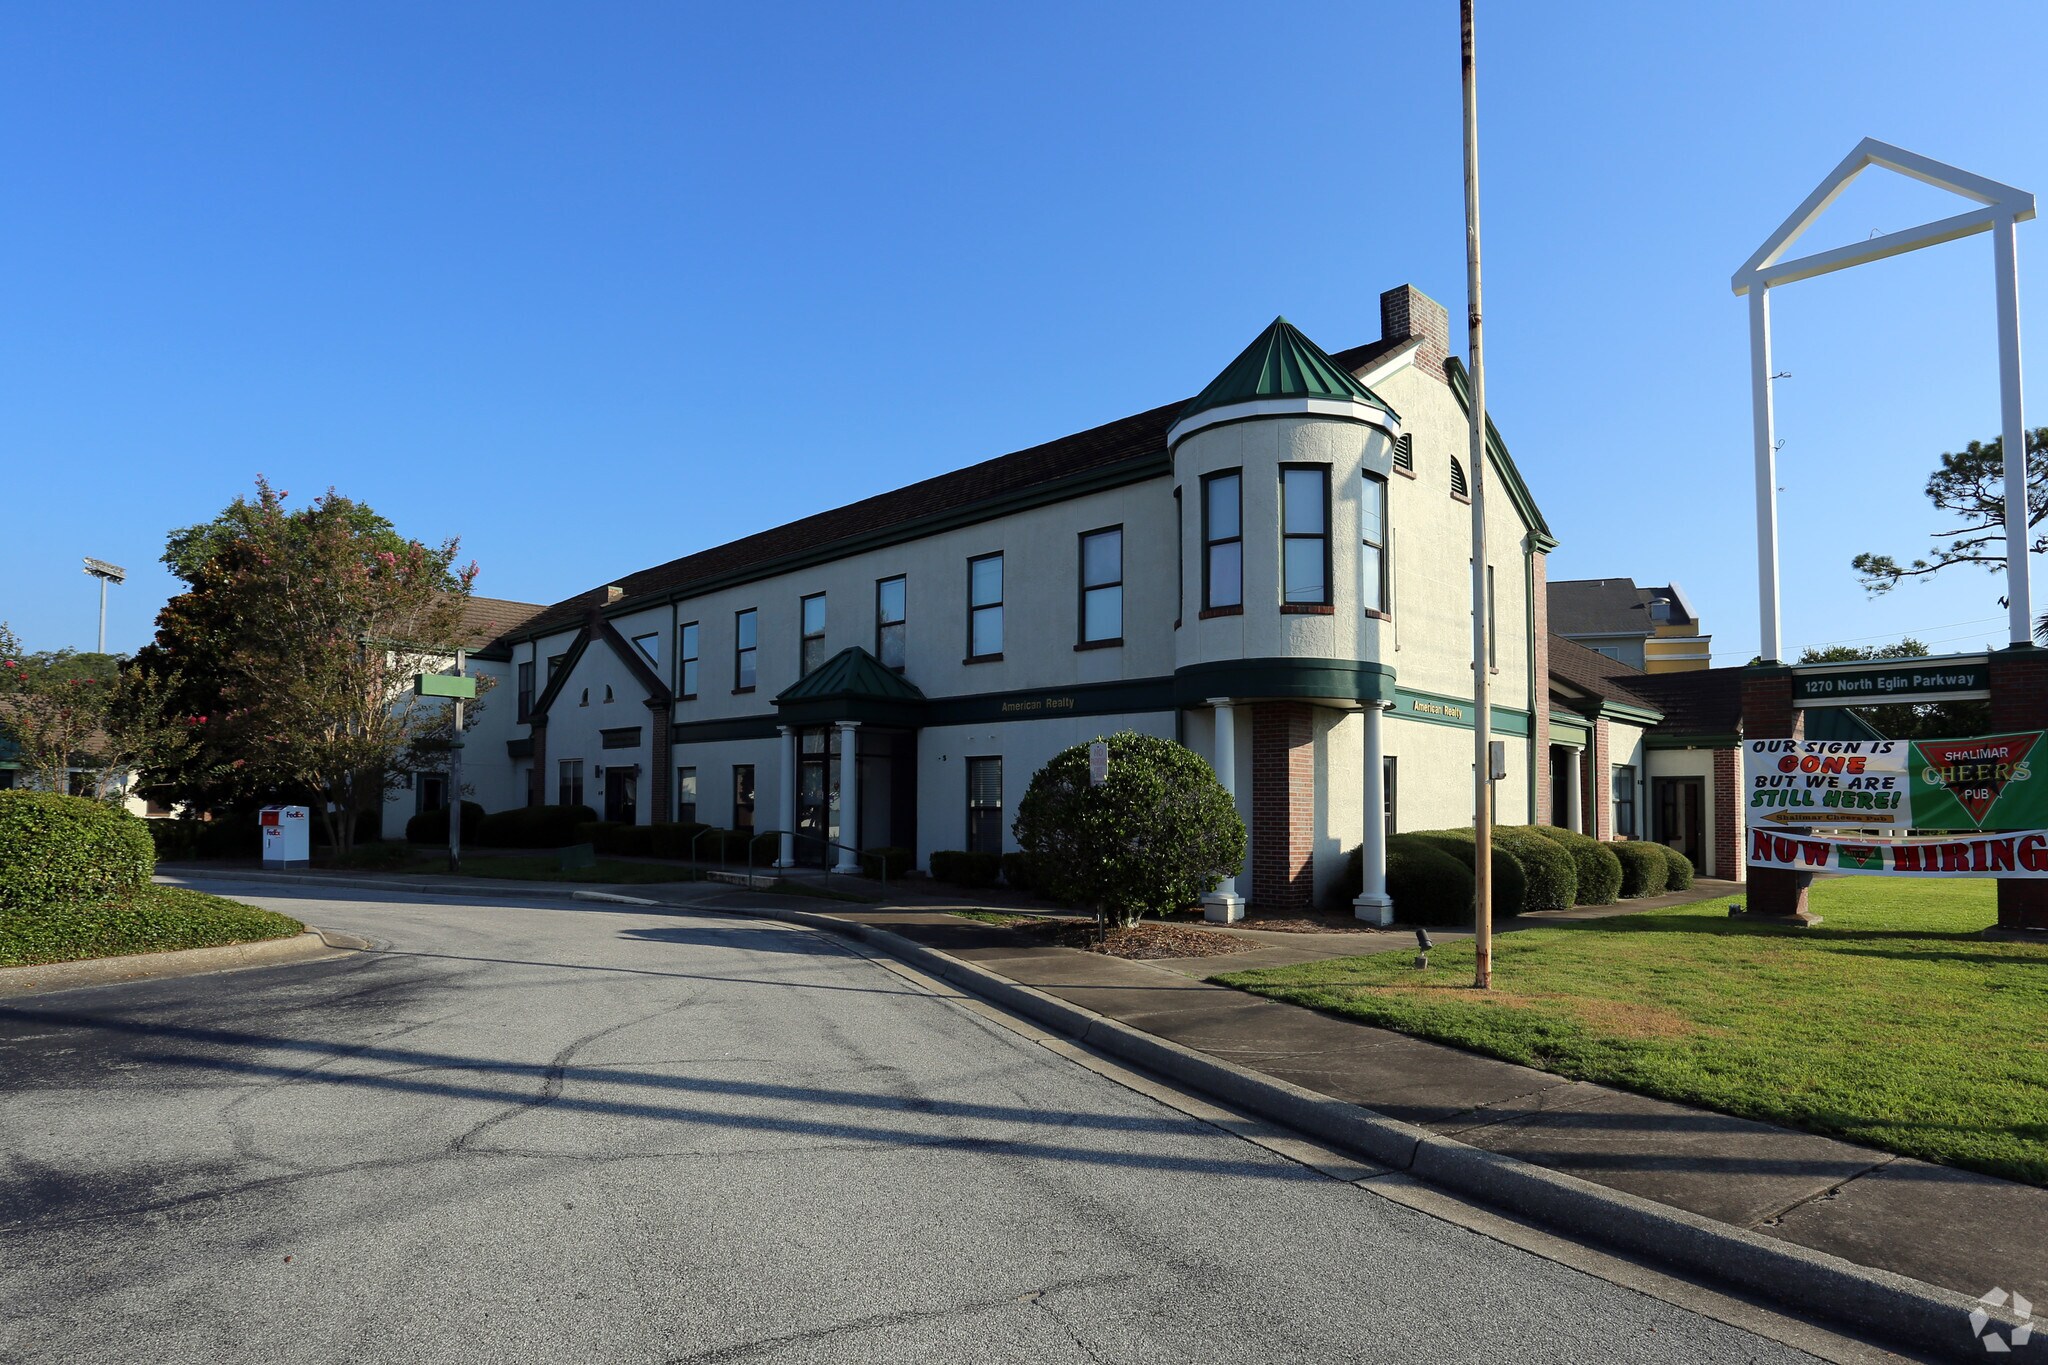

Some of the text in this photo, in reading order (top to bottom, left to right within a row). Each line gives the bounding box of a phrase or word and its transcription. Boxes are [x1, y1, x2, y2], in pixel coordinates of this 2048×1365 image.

[1805, 674, 1975, 692] 1270 North Eglin Parkway
[1001, 697, 1075, 712] American Realty
[1413, 700, 1463, 720] American Realty
[1752, 740, 1895, 754] OUR SIGN IS
[1944, 747, 2009, 762] SHALIMAR
[1777, 755, 1867, 774] GONE
[1921, 761, 2032, 785] CHEERS
[1755, 775, 1896, 790] BUT WE ARE
[1750, 789, 1902, 810] STILL HERE!
[1964, 788, 1989, 800] PUB
[1826, 814, 1862, 822] Cheers
[1752, 830, 2048, 872] NOW HIRING
